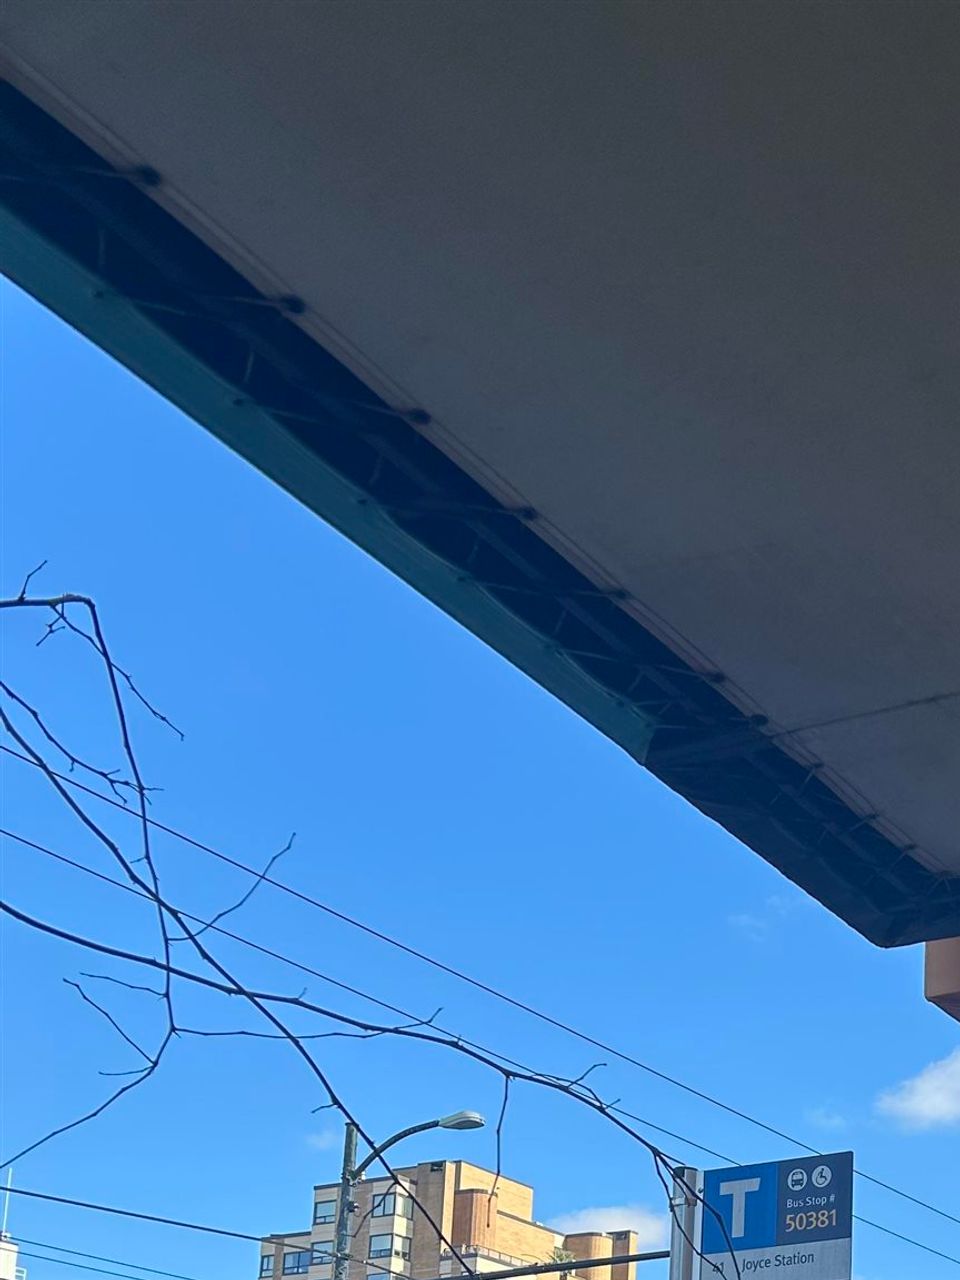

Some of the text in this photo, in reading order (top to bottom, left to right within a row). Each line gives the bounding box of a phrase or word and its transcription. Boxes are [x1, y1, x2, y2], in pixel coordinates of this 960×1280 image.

[720, 1177, 761, 1238] T
[786, 1197, 804, 1208] Bus
[806, 1195, 827, 1208] Stop
[785, 1209, 837, 1233] 50381
[741, 1251, 814, 1273] Joyce Station
